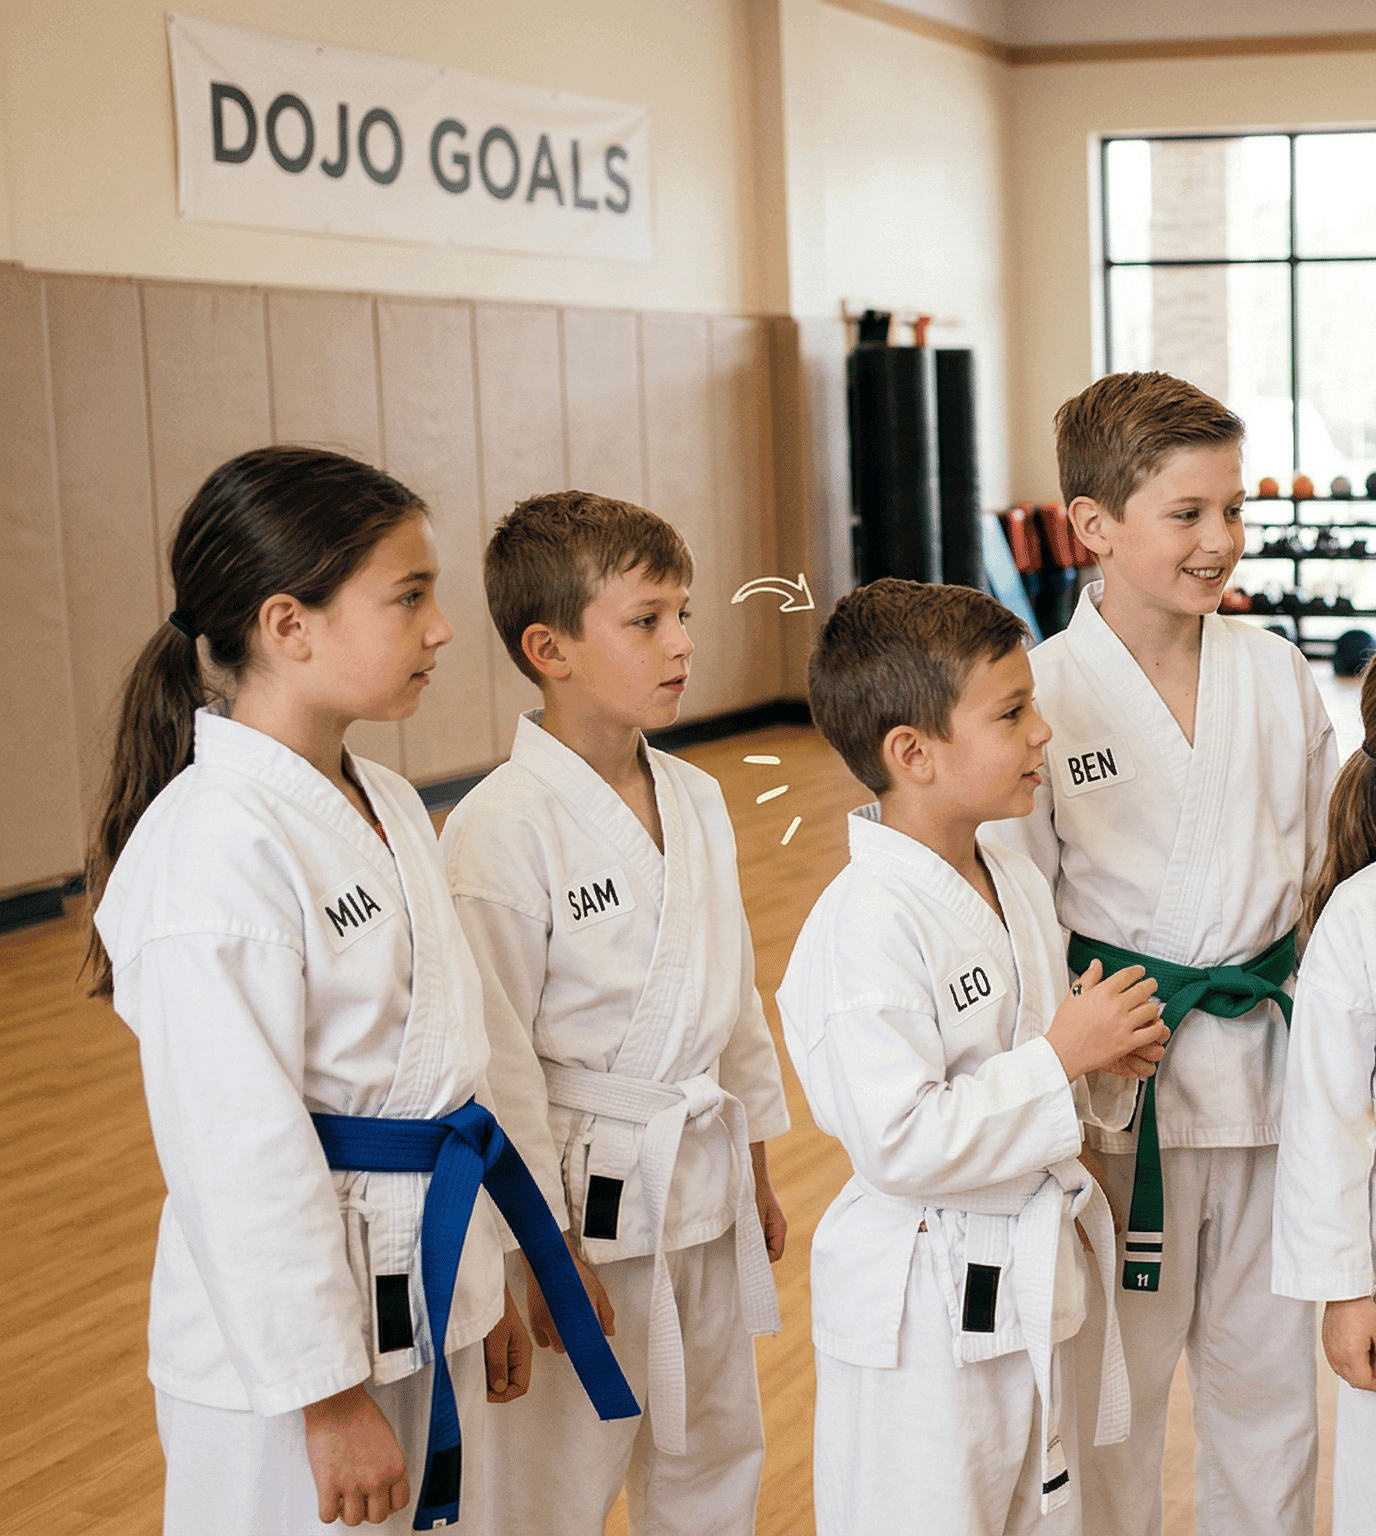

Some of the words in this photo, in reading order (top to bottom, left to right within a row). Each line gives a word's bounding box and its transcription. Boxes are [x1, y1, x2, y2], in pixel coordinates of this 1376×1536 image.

[209, 80, 405, 186] DOJO
[428, 117, 632, 214] GOALS
[1067, 748, 1118, 786] BEN
[325, 885, 381, 937] MIA
[568, 878, 619, 921] SAM
[949, 967, 991, 1012] LEO
